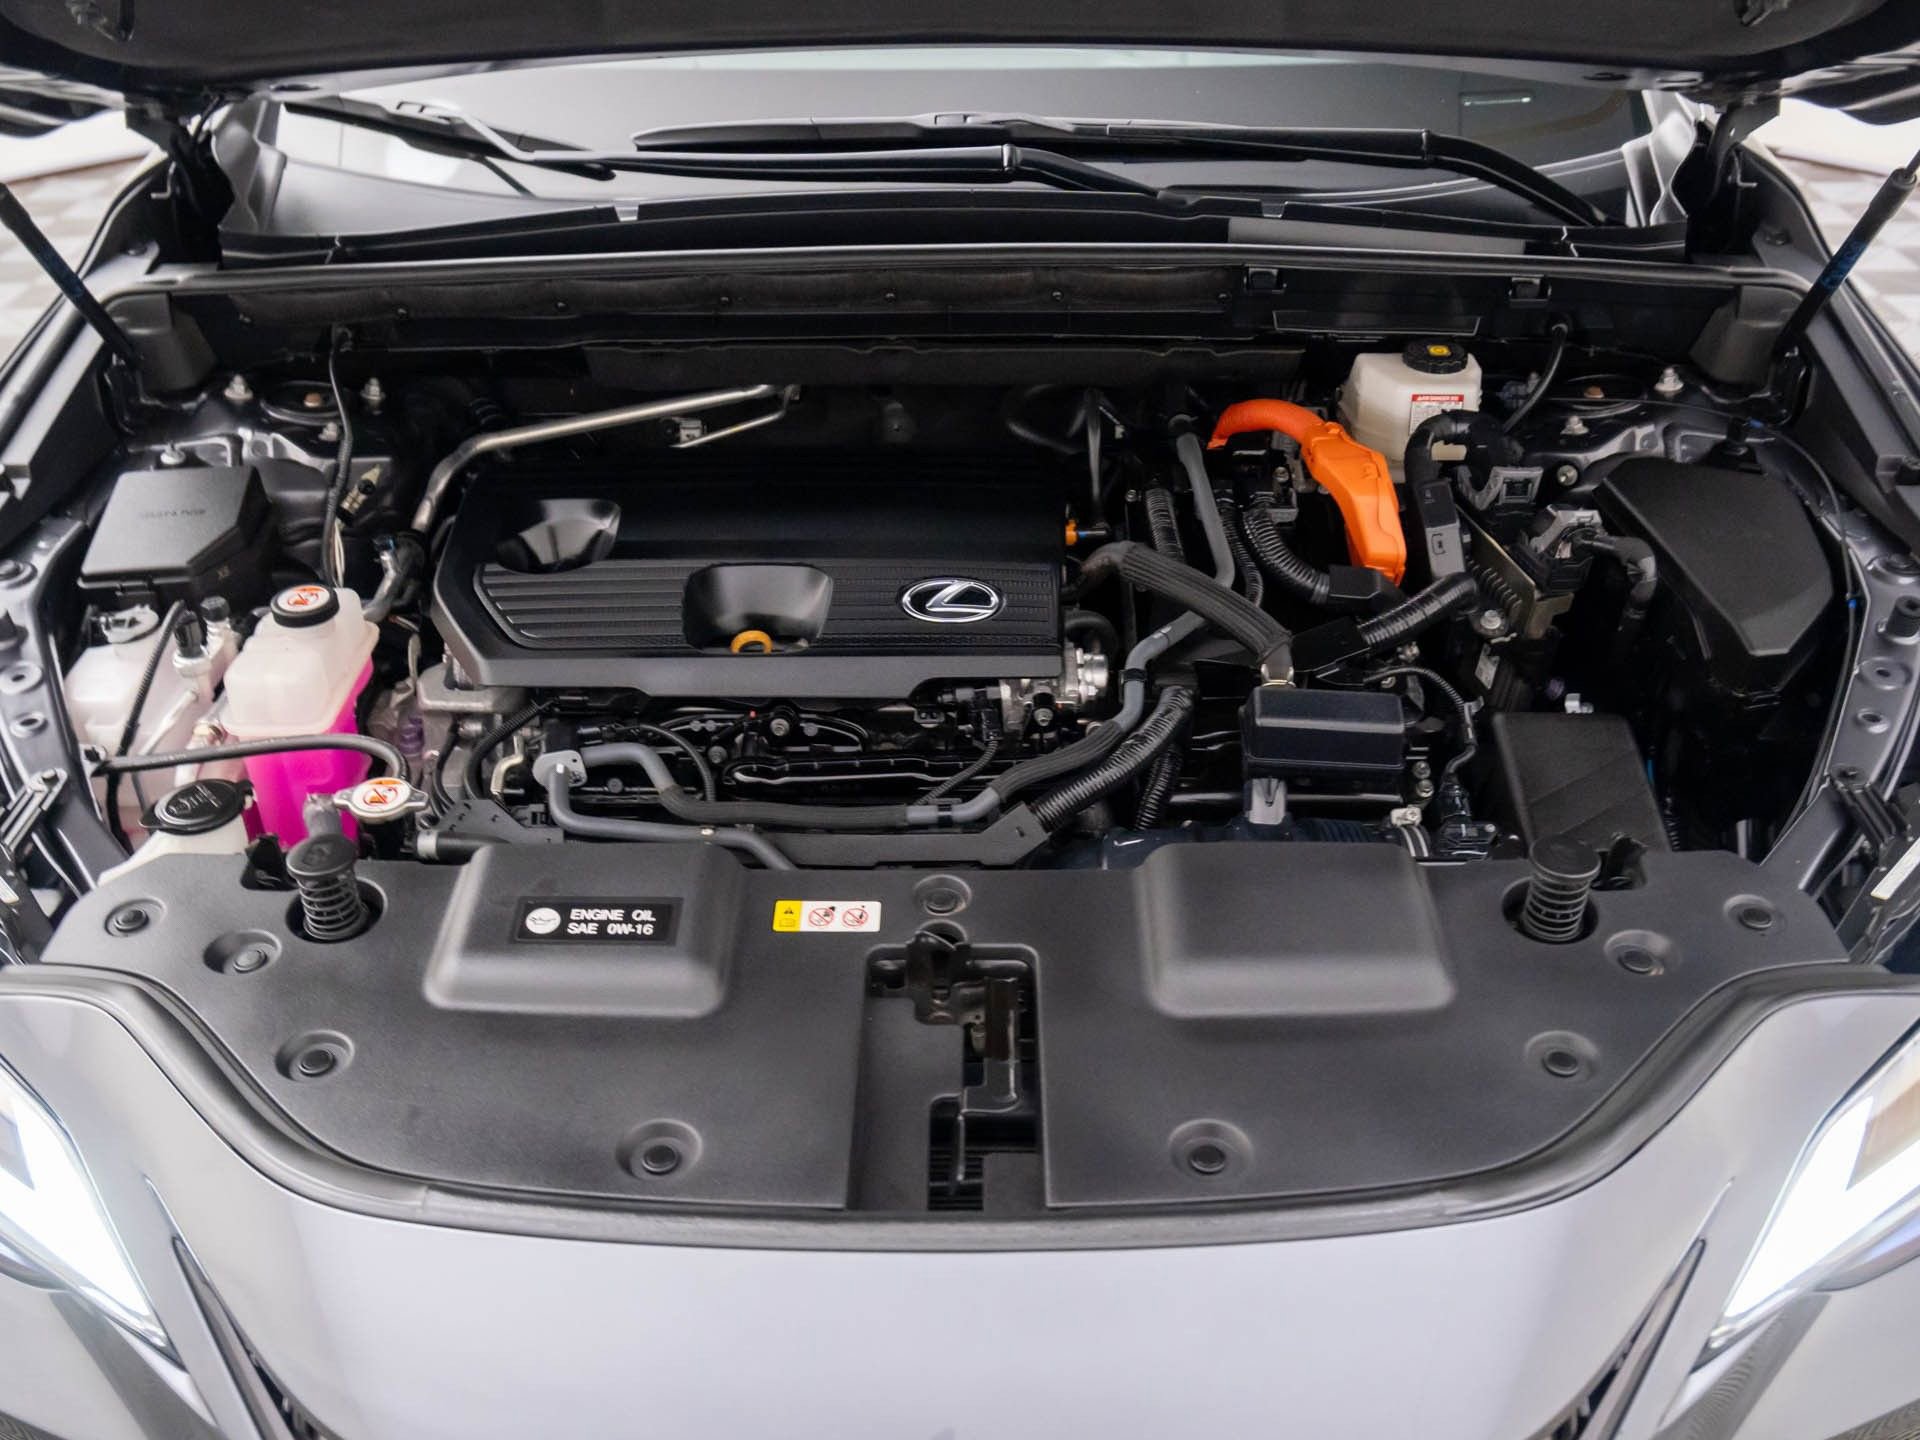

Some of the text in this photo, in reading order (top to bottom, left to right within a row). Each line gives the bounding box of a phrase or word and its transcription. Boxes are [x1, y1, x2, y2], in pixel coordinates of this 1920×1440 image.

[570, 908, 657, 921] ENGINE OIL
[567, 922, 654, 935] SAE 0W-16
